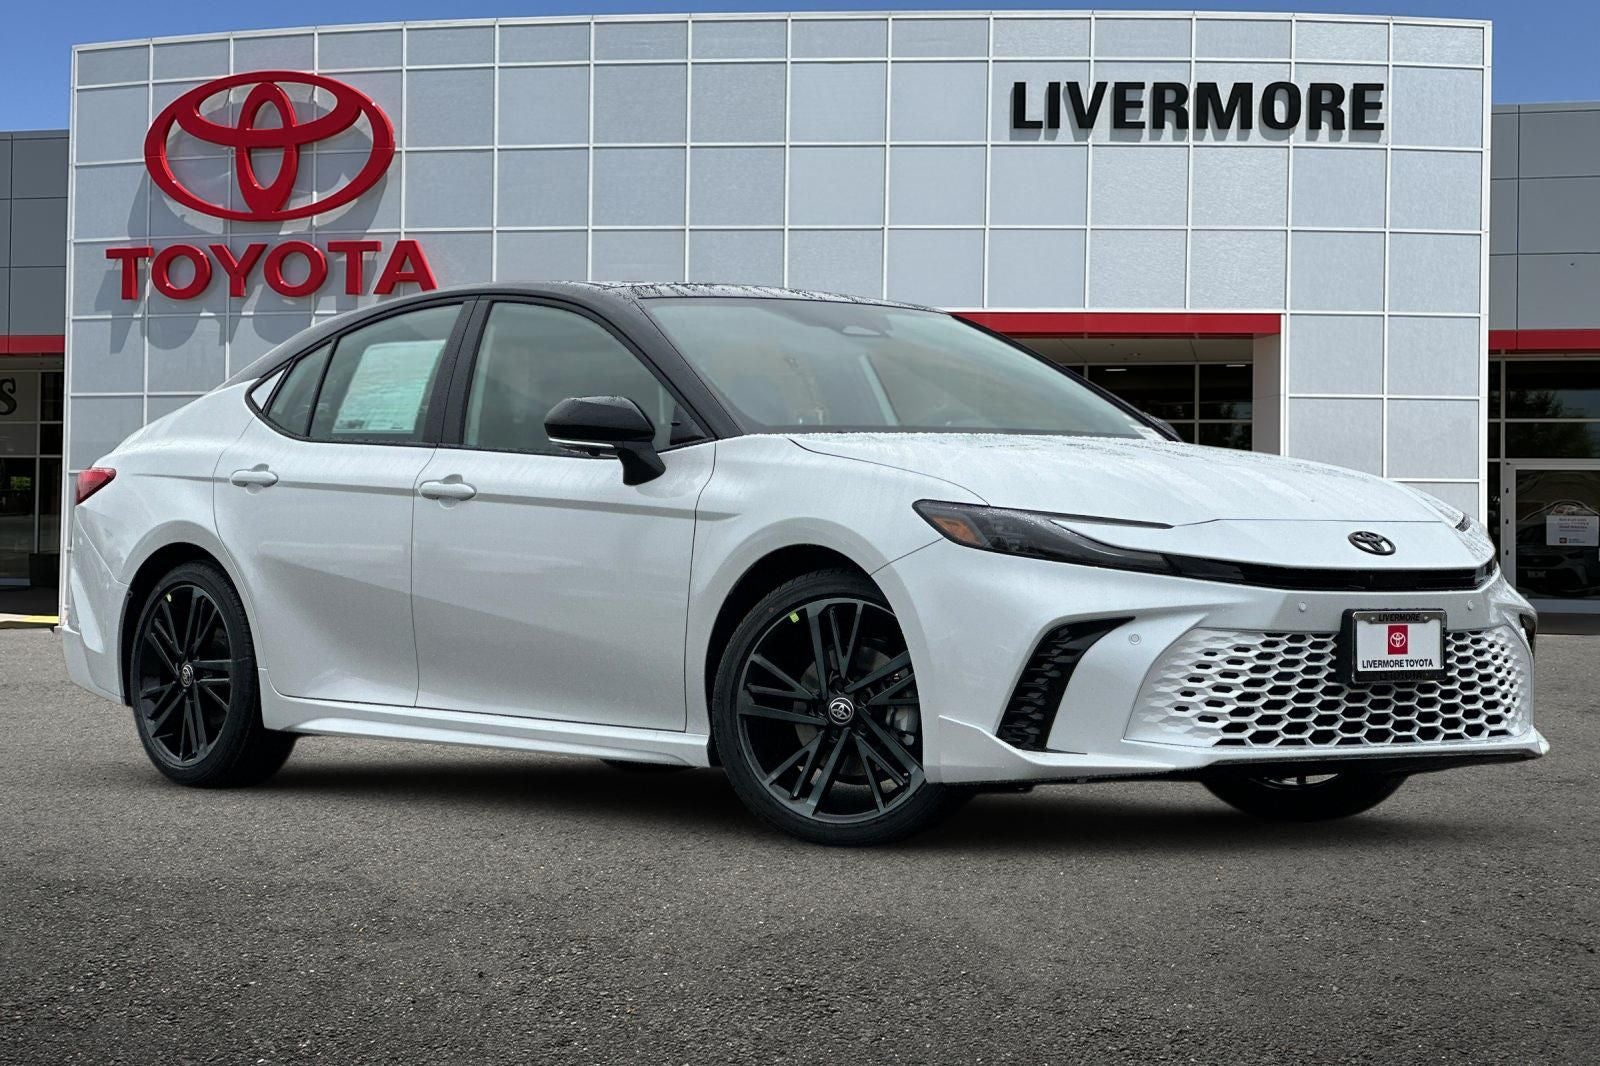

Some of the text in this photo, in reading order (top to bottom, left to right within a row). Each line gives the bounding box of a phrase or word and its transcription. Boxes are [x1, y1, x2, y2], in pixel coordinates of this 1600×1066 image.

[1013, 81, 1385, 131] LIVERMORE
[105, 239, 437, 301] TOYOTA
[1378, 613, 1420, 622] LIVERMORE
[1362, 659, 1433, 669] LIVERMORE TOYOTA
